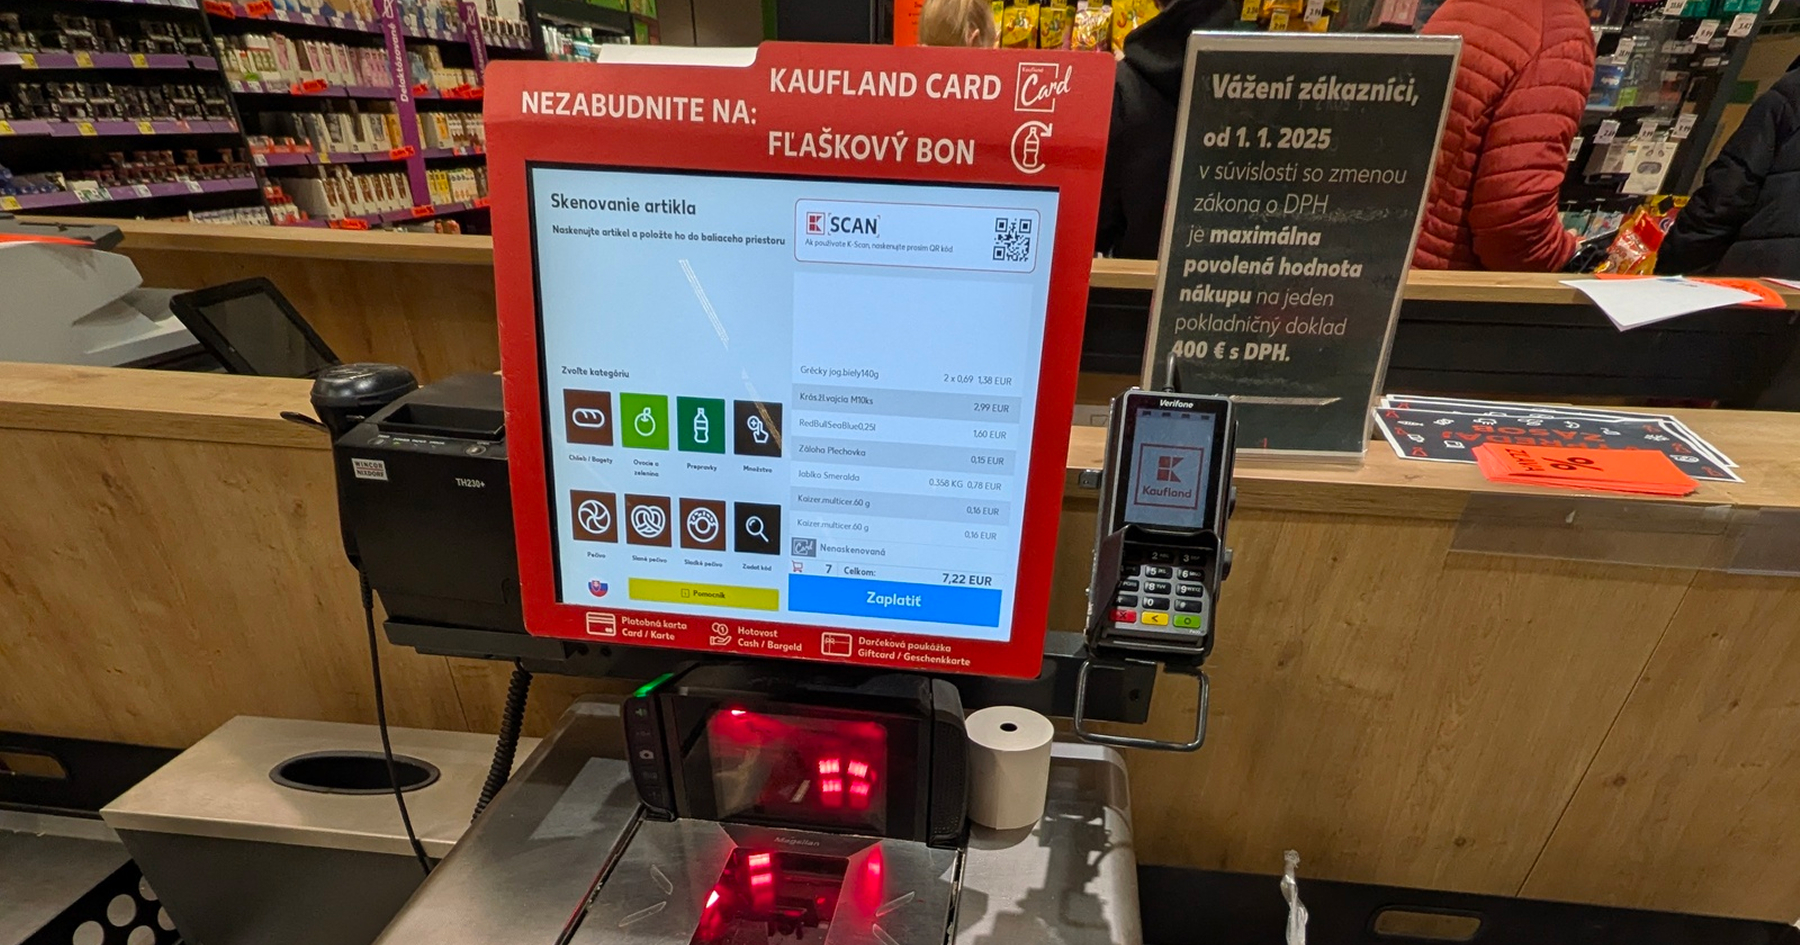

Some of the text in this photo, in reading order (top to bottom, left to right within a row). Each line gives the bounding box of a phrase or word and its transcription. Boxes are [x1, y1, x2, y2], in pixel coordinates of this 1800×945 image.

[388, 22, 409, 103] Delaktózované
[770, 68, 1001, 100] KAUFLAND CARD
[1021, 65, 1072, 106] Card
[1212, 73, 1420, 106] Vážení zákazníci,
[521, 91, 757, 125] NEZABUDNITE NA:
[768, 127, 975, 165] FĽAŠKOVÝ BON
[1203, 126, 1332, 149] od 1. 1. 2025
[1199, 160, 1407, 184] v súvislosti so zmenou
[551, 193, 696, 215] Skenovanie artikla
[1193, 191, 1329, 214] zákona o DPH
[830, 216, 878, 235] SCAN
[552, 225, 600, 238] Naskenujte
[602, 229, 630, 238] artikel
[639, 230, 673, 241] položte
[675, 232, 686, 240] ho
[687, 233, 699, 241] do
[701, 232, 743, 244] baliaceho
[745, 235, 786, 246] priestoru
[1186, 224, 1322, 248] je maximálna
[805, 238, 813, 246] Ak
[847, 241, 871, 250] K-Scan,
[872, 242, 906, 252] naskenujte
[929, 244, 940, 252] QR
[1183, 255, 1363, 278] povolená hodnota
[1179, 284, 1334, 310] nákupu na jeden
[1174, 313, 1348, 338] pokladničný doklad
[1172, 340, 1291, 362] 400 € s DPH.
[590, 368, 630, 379] kategóriu
[943, 374, 950, 383] 2
[956, 375, 974, 385] 0,69
[994, 377, 1012, 386] EUR
[973, 402, 990, 412] 2,99
[992, 404, 1010, 413] EUR
[1160, 399, 1194, 409] Verifone
[989, 430, 1007, 440] EUR
[799, 444, 826, 454] Záloha
[827, 446, 866, 457] Plechovka
[987, 457, 1005, 466] EUR
[354, 461, 383, 469] WINCOR
[686, 463, 718, 472] Prepravky
[455, 477, 486, 489] TH230+
[823, 471, 860, 482] Smeralda
[951, 480, 963, 489] KG
[985, 482, 1002, 491] EUR
[1142, 485, 1192, 498] Kaufland
[865, 501, 871, 509] g
[983, 507, 1000, 516] EUR
[863, 525, 869, 533] g
[981, 532, 997, 541] EUR
[820, 543, 886, 556] Nenaskenovaná
[825, 564, 992, 586] 7 Celkom: 7,22 EUR
[1150, 567, 1157, 575] 5
[1182, 570, 1189, 578] 6
[1181, 585, 1187, 593] 9
[866, 591, 922, 608] Zaplatiť
[1147, 598, 1154, 606] 0
[621, 615, 688, 631] Platobná karta
[622, 628, 642, 639] Card
[650, 631, 676, 642] Karte
[737, 638, 759, 648] Cash
[767, 640, 803, 653] Bargeld
[858, 635, 952, 654] Darčeková poukážka
[858, 648, 896, 660] Giftcard
[903, 651, 971, 666] Geschenkkarte
[774, 837, 820, 847] Magellan
